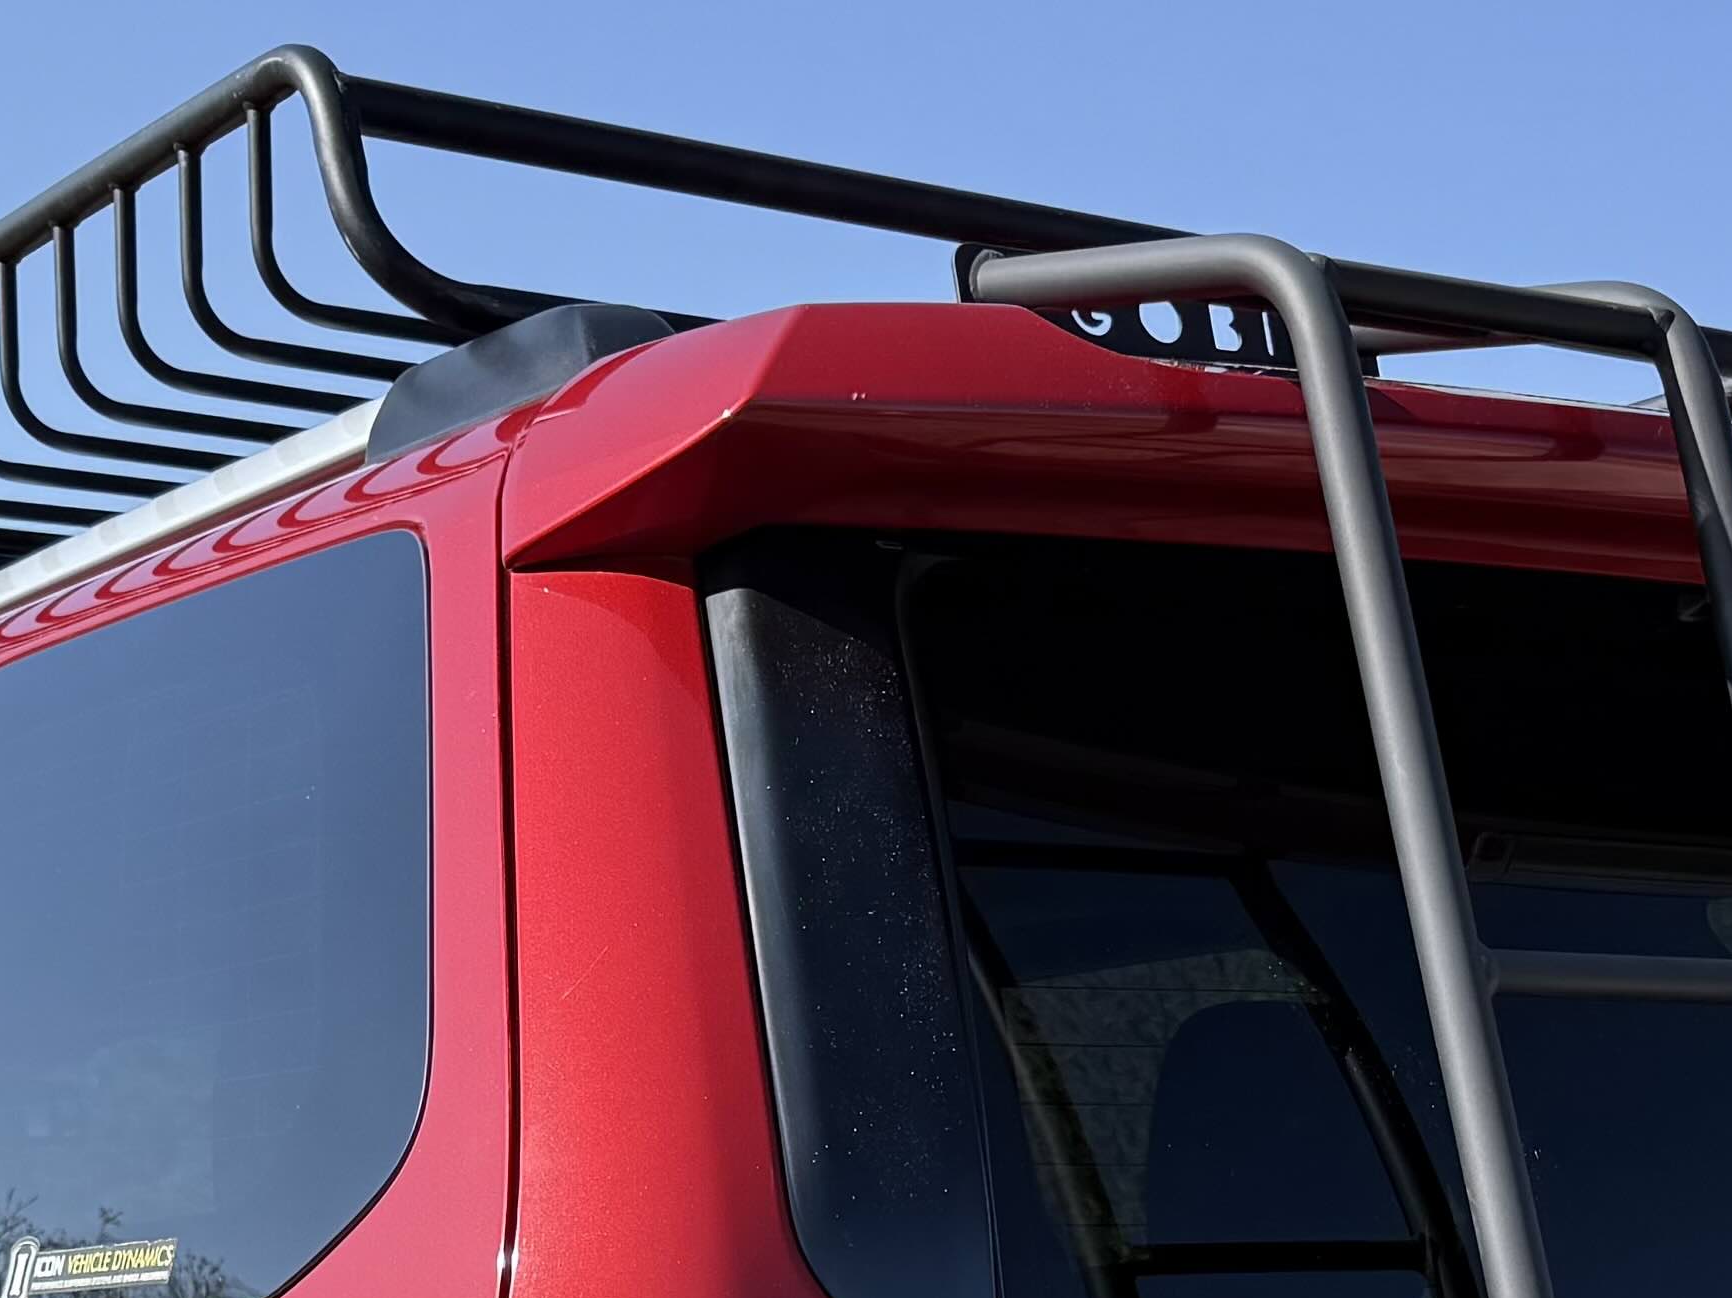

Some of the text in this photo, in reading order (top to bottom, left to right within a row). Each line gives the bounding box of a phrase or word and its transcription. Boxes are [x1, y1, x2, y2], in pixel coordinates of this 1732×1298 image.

[1070, 300, 1275, 357] GOBI
[33, 1244, 175, 1278] ICON VEHICLE DYNAMICS
